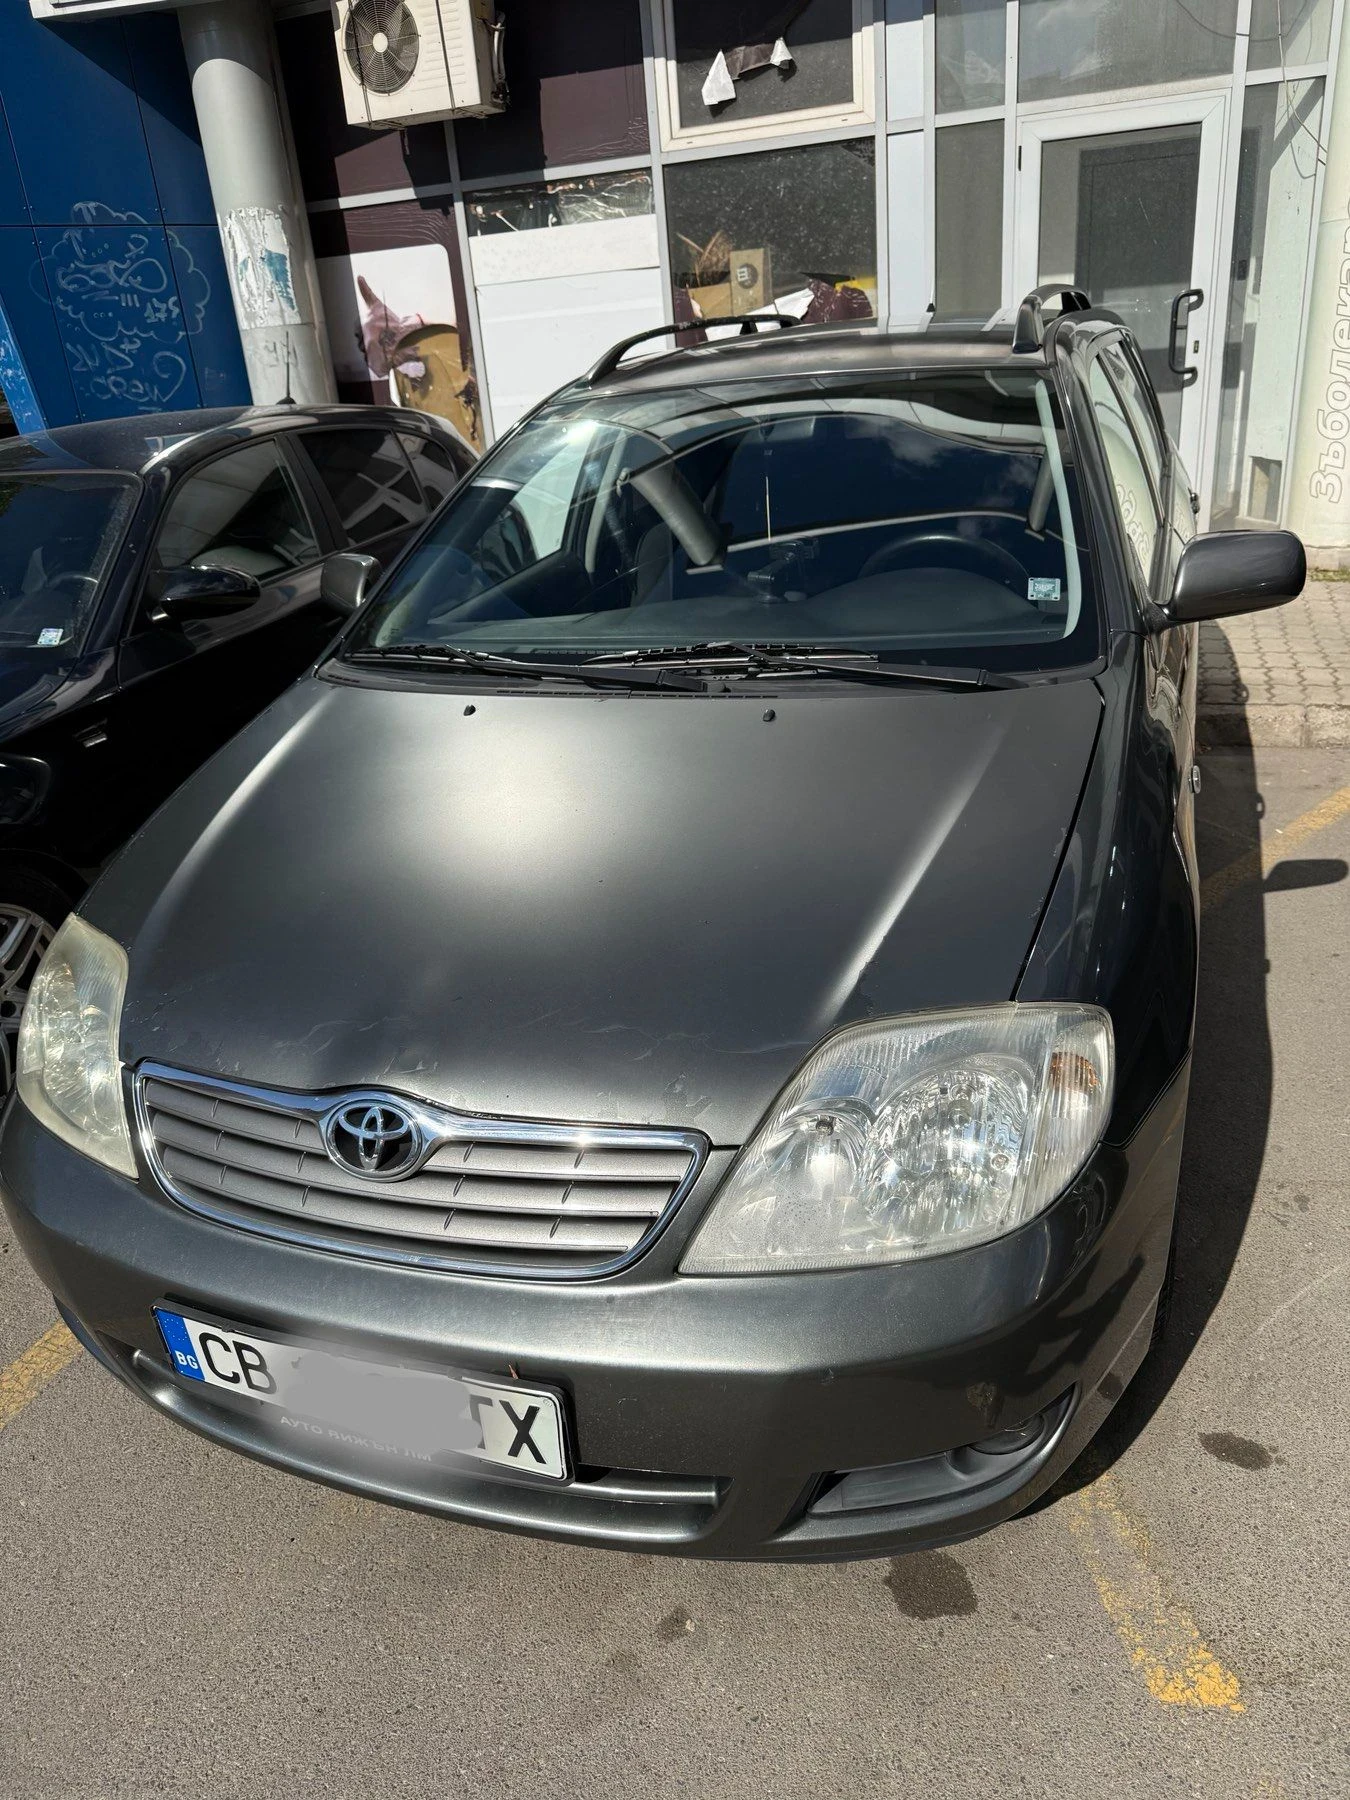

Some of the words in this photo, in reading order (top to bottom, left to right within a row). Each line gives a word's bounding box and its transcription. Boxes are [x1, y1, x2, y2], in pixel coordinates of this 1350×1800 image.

[1309, 196, 1350, 503] Зъболек
[174, 1350, 199, 1370] BG
[281, 1416, 322, 1434] АУТО
